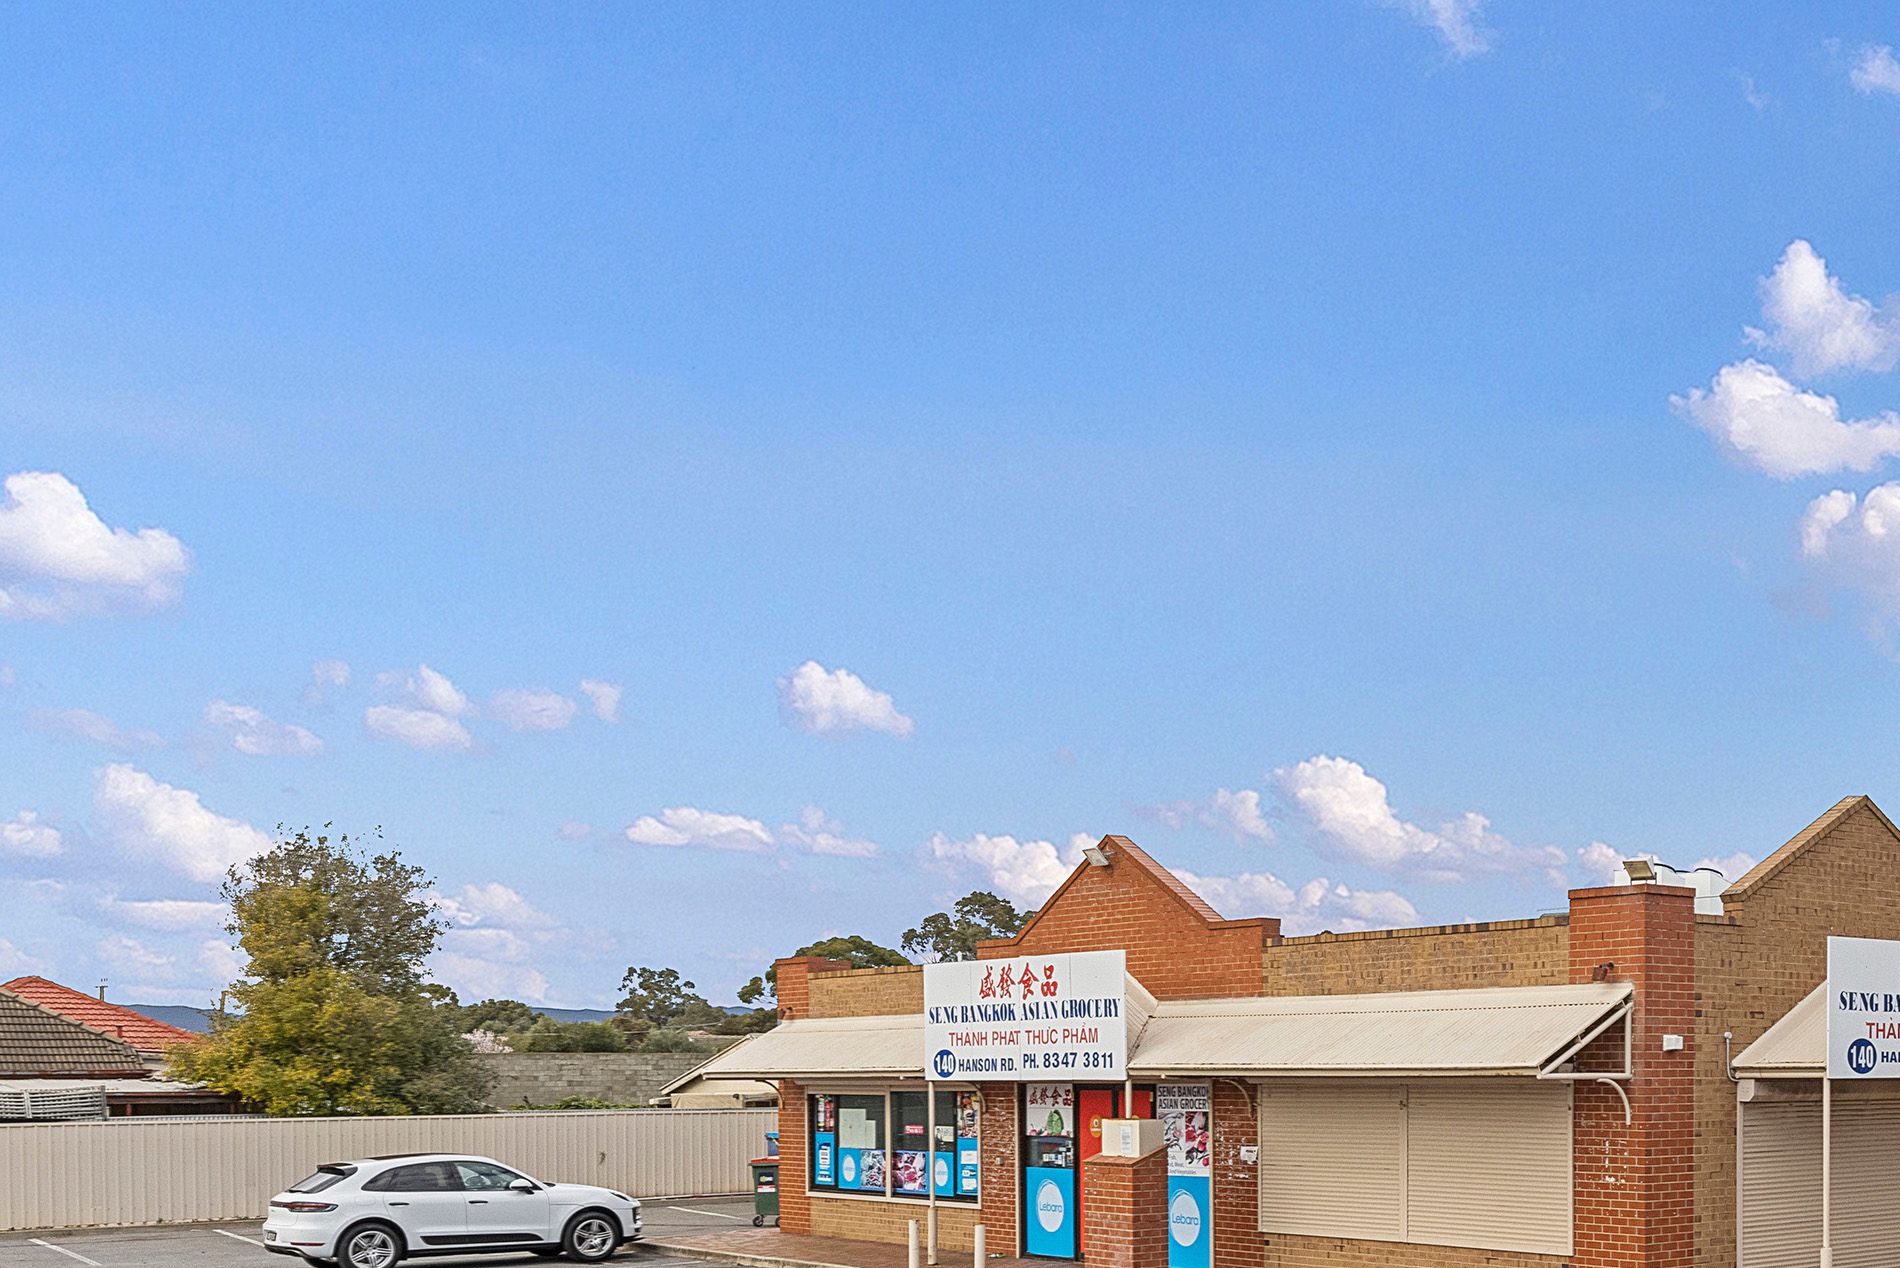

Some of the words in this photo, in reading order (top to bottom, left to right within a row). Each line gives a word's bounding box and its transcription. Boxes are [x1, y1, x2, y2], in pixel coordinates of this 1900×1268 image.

[978, 962, 1059, 1000] 盛發食品
[928, 1006, 958, 1024] SENG
[961, 1003, 1016, 1023] BANGKOK
[1019, 1000, 1059, 1021] ASIAN
[1061, 998, 1121, 1019] GROCERY
[1839, 991, 1879, 1013] SENG
[934, 1053, 954, 1073] 140
[958, 1057, 998, 1073] HANSON
[1000, 1056, 1018, 1072] RD.
[1022, 1053, 1040, 1069] PH.
[1043, 1051, 1078, 1069] 8347
[1083, 1051, 1114, 1069] 3811
[1850, 1045, 1874, 1069] 140
[1158, 1086, 1176, 1098] SENG
[1158, 1098, 1179, 1110] ASIAN
[1039, 1200, 1063, 1213] Lebara
[1172, 1213, 1199, 1226] Lebara
